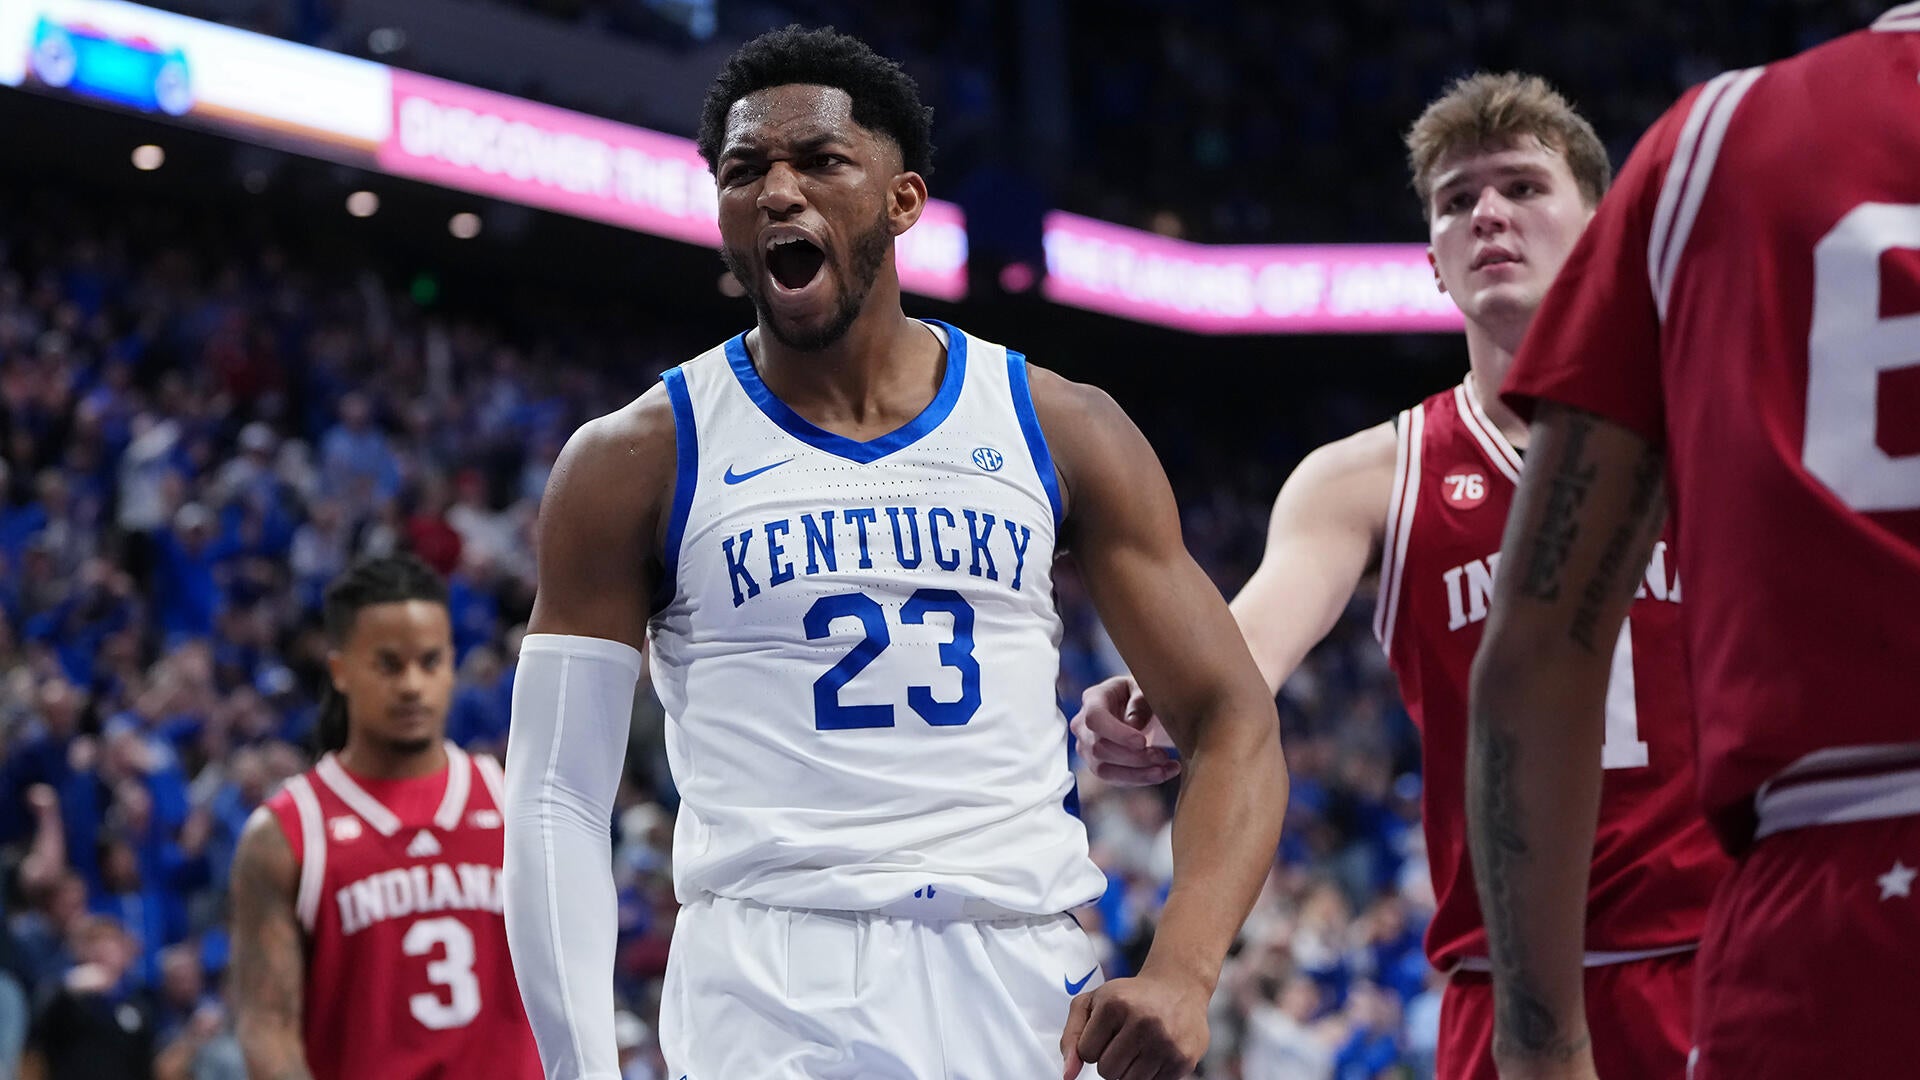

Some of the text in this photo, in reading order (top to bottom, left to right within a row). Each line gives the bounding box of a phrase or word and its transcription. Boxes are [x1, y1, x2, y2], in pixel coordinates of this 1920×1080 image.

[972, 447, 1003, 472] SEC
[722, 507, 1031, 608] KENTUCKY
[803, 588, 982, 731] 23
[403, 917, 482, 1030] 3
